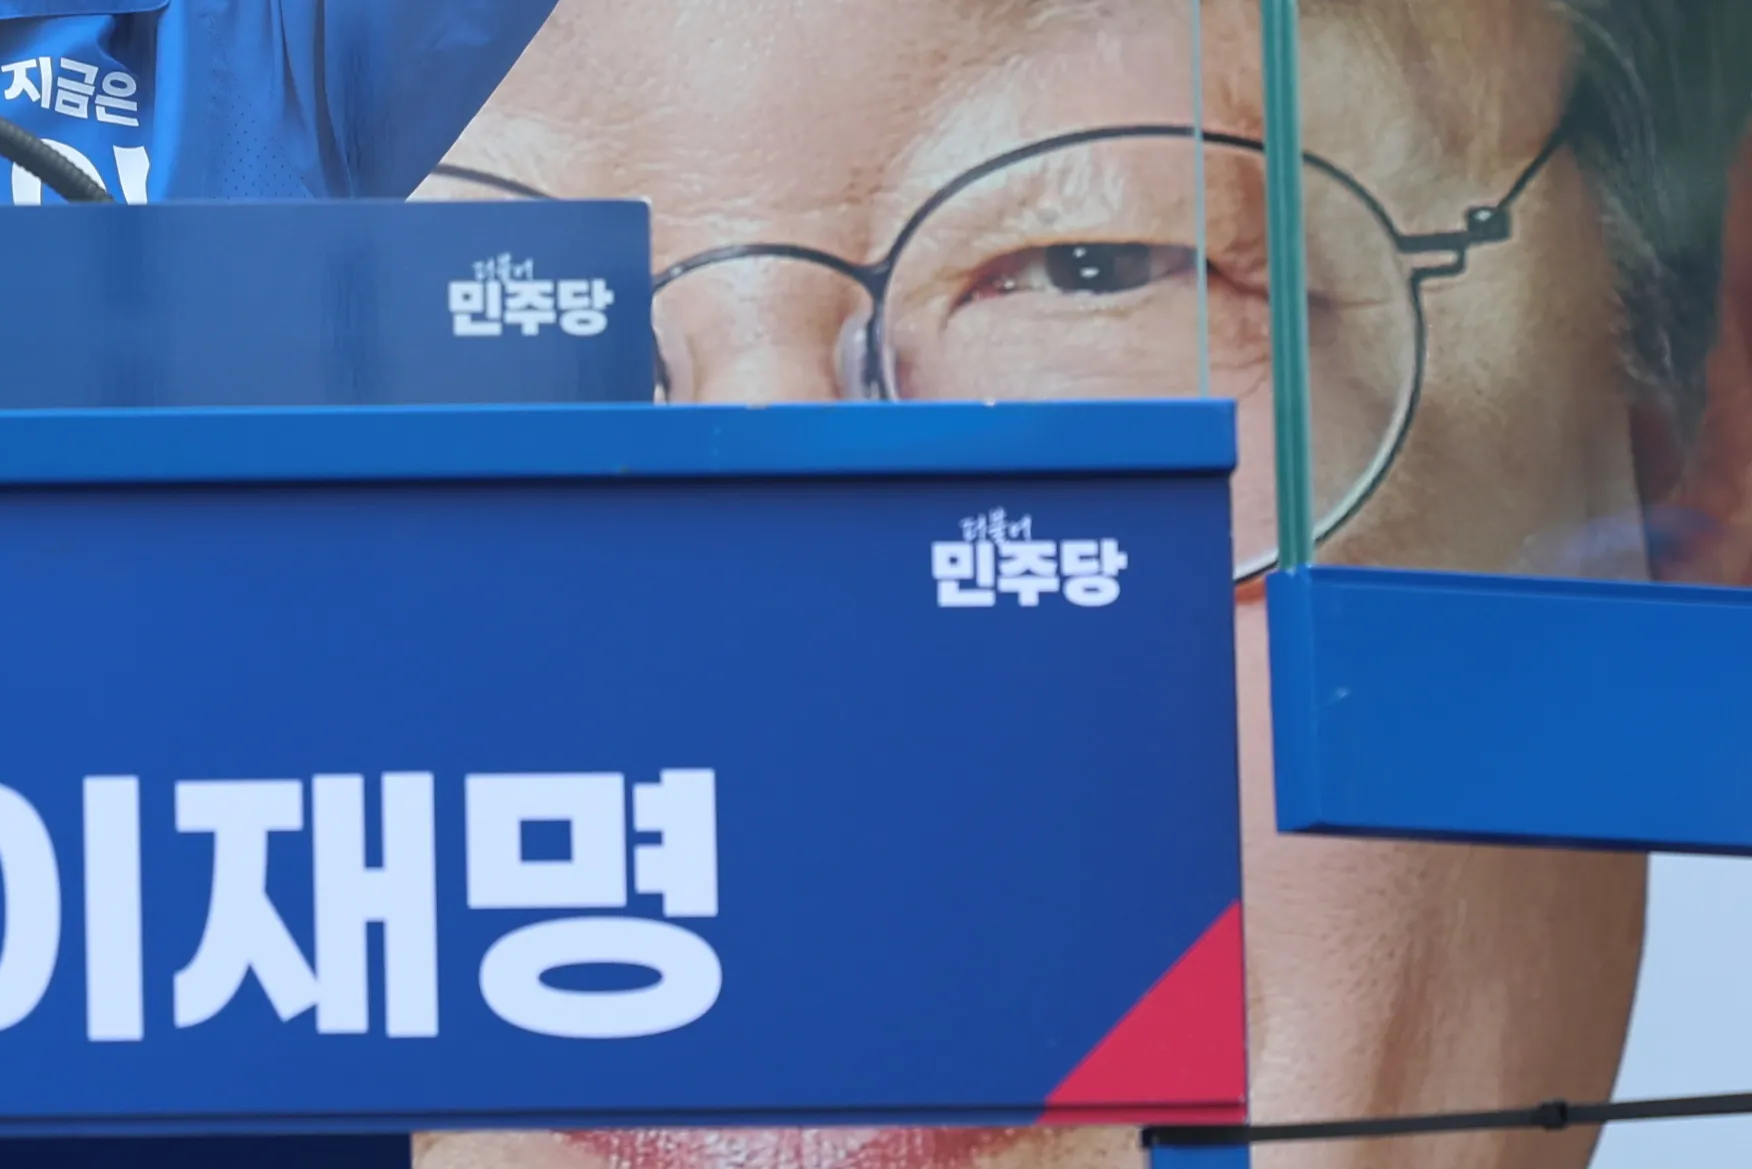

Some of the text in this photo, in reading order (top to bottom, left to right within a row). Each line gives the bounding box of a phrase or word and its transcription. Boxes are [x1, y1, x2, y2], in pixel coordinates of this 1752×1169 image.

[1, 56, 140, 127] 지금은
[449, 278, 615, 336] 민주당
[931, 537, 1128, 607] 민주당
